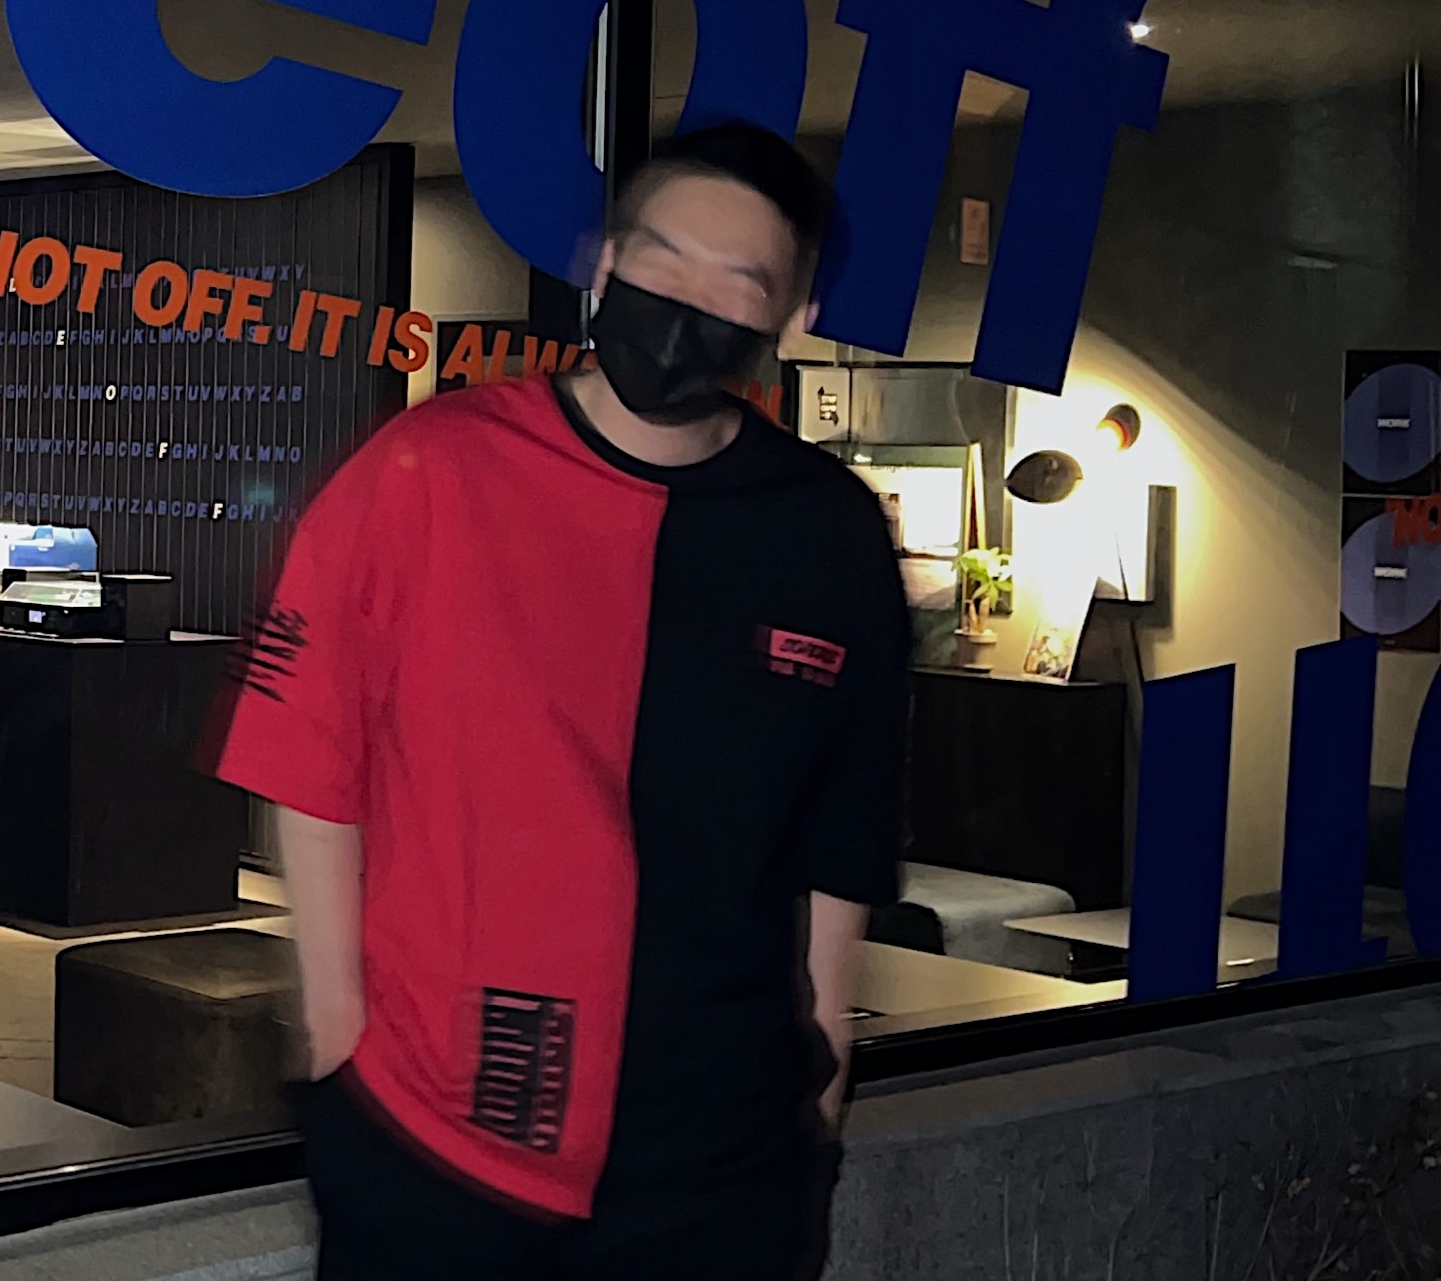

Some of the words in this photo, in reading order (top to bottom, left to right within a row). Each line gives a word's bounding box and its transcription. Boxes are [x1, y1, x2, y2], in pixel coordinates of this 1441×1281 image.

[133, 260, 274, 346] OFF.
[288, 288, 362, 358] IT
[367, 304, 433, 374] IS
[440, 323, 598, 388] ALW
